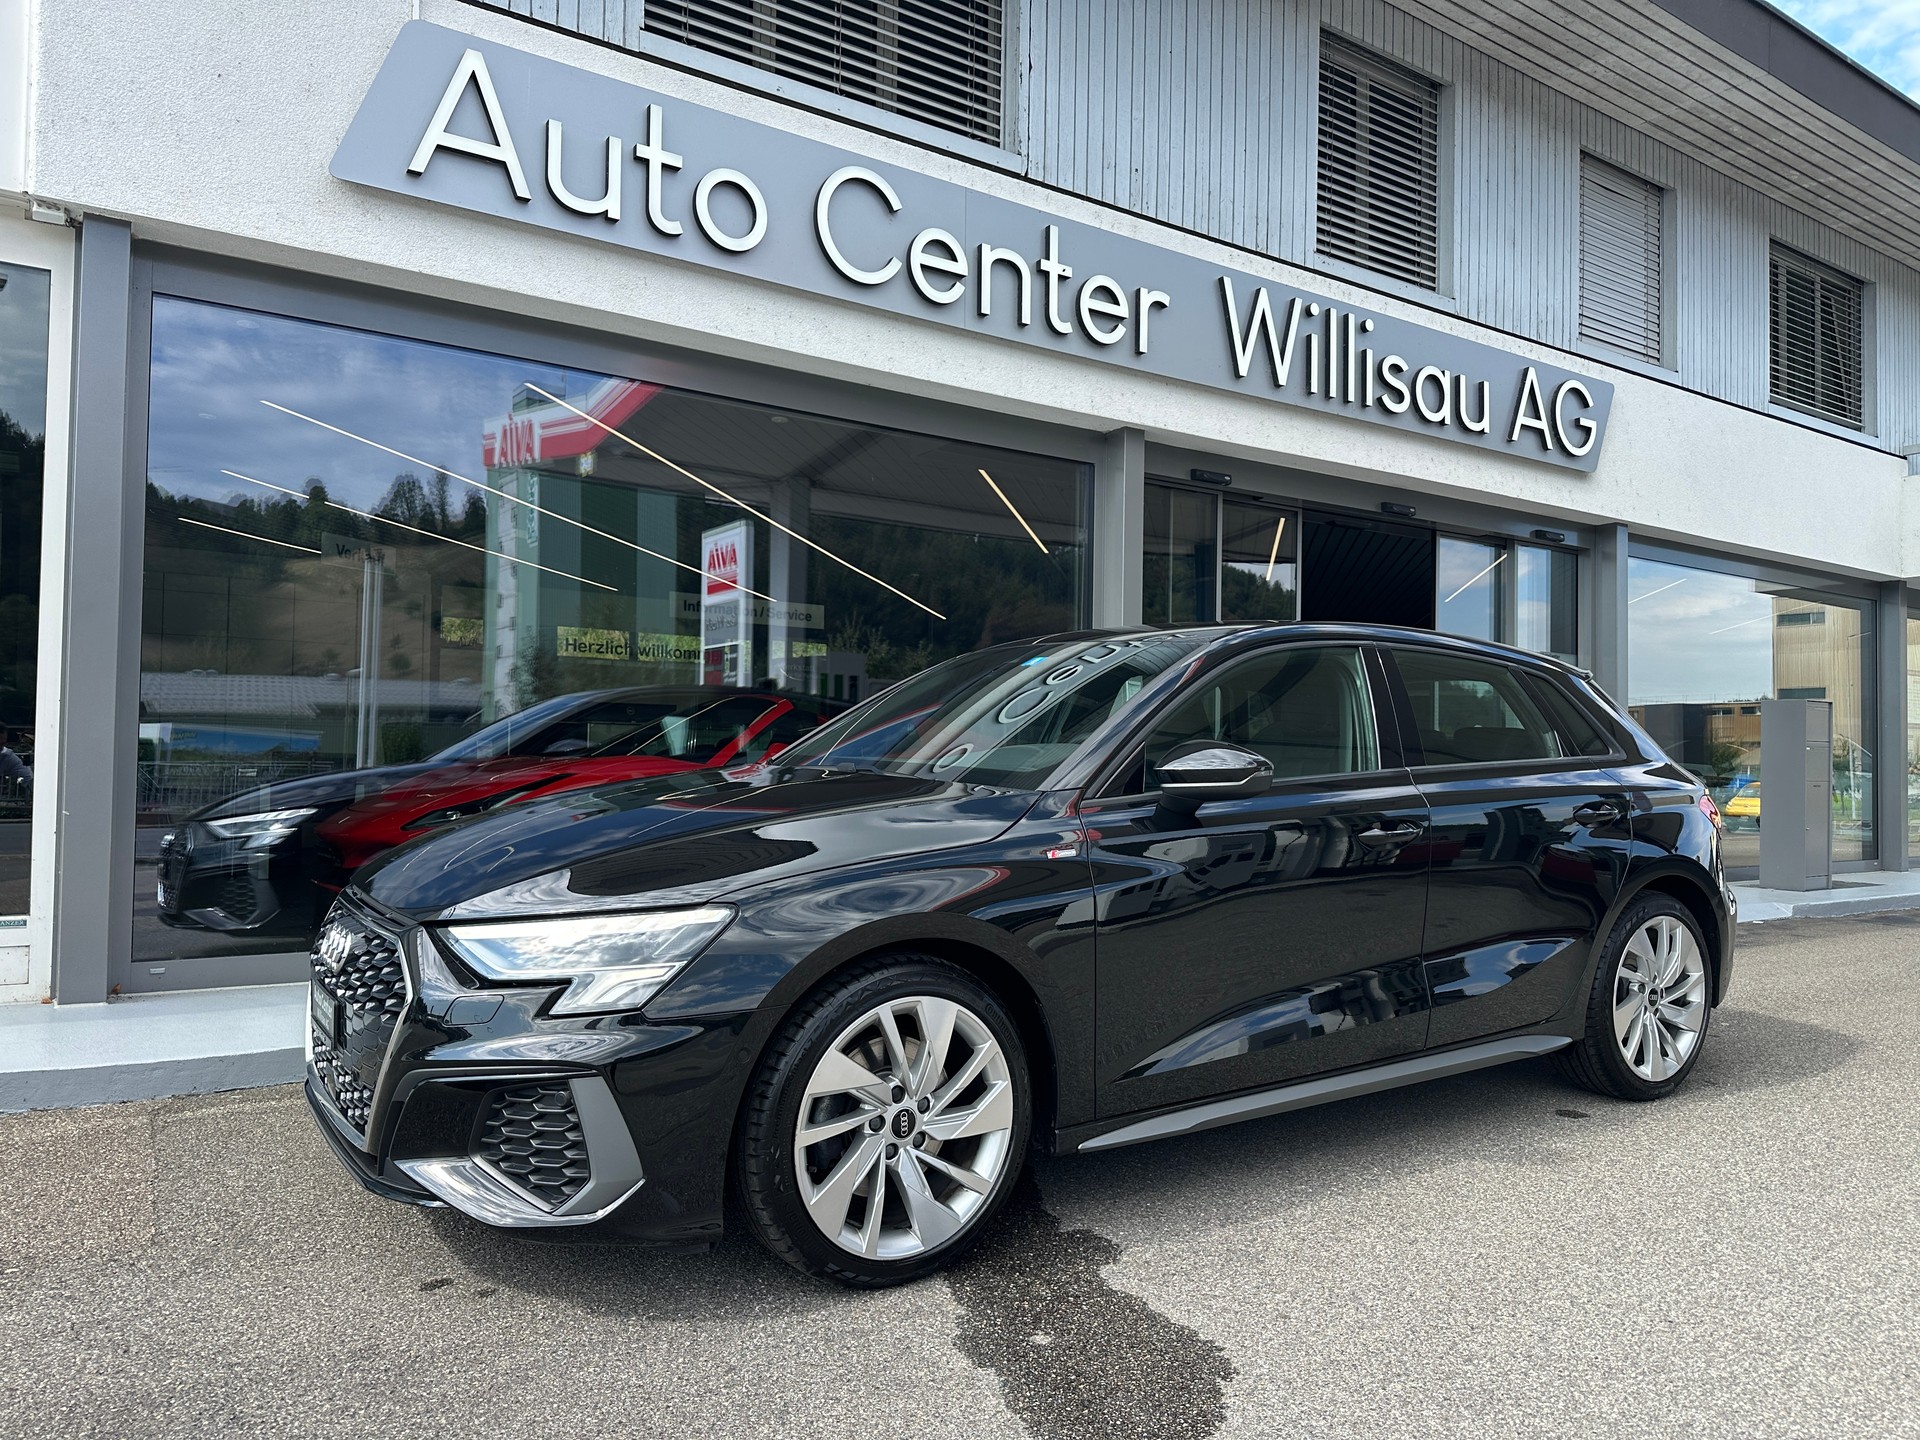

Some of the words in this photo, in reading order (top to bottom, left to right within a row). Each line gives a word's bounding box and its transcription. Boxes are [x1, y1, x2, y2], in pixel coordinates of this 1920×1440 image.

[406, 48, 768, 253] Auto
[814, 165, 1170, 355] Center
[1218, 276, 1490, 434] Willisau
[1507, 365, 1597, 458] AG
[766, 608, 812, 622] Service
[565, 637, 634, 656] Herzlich
